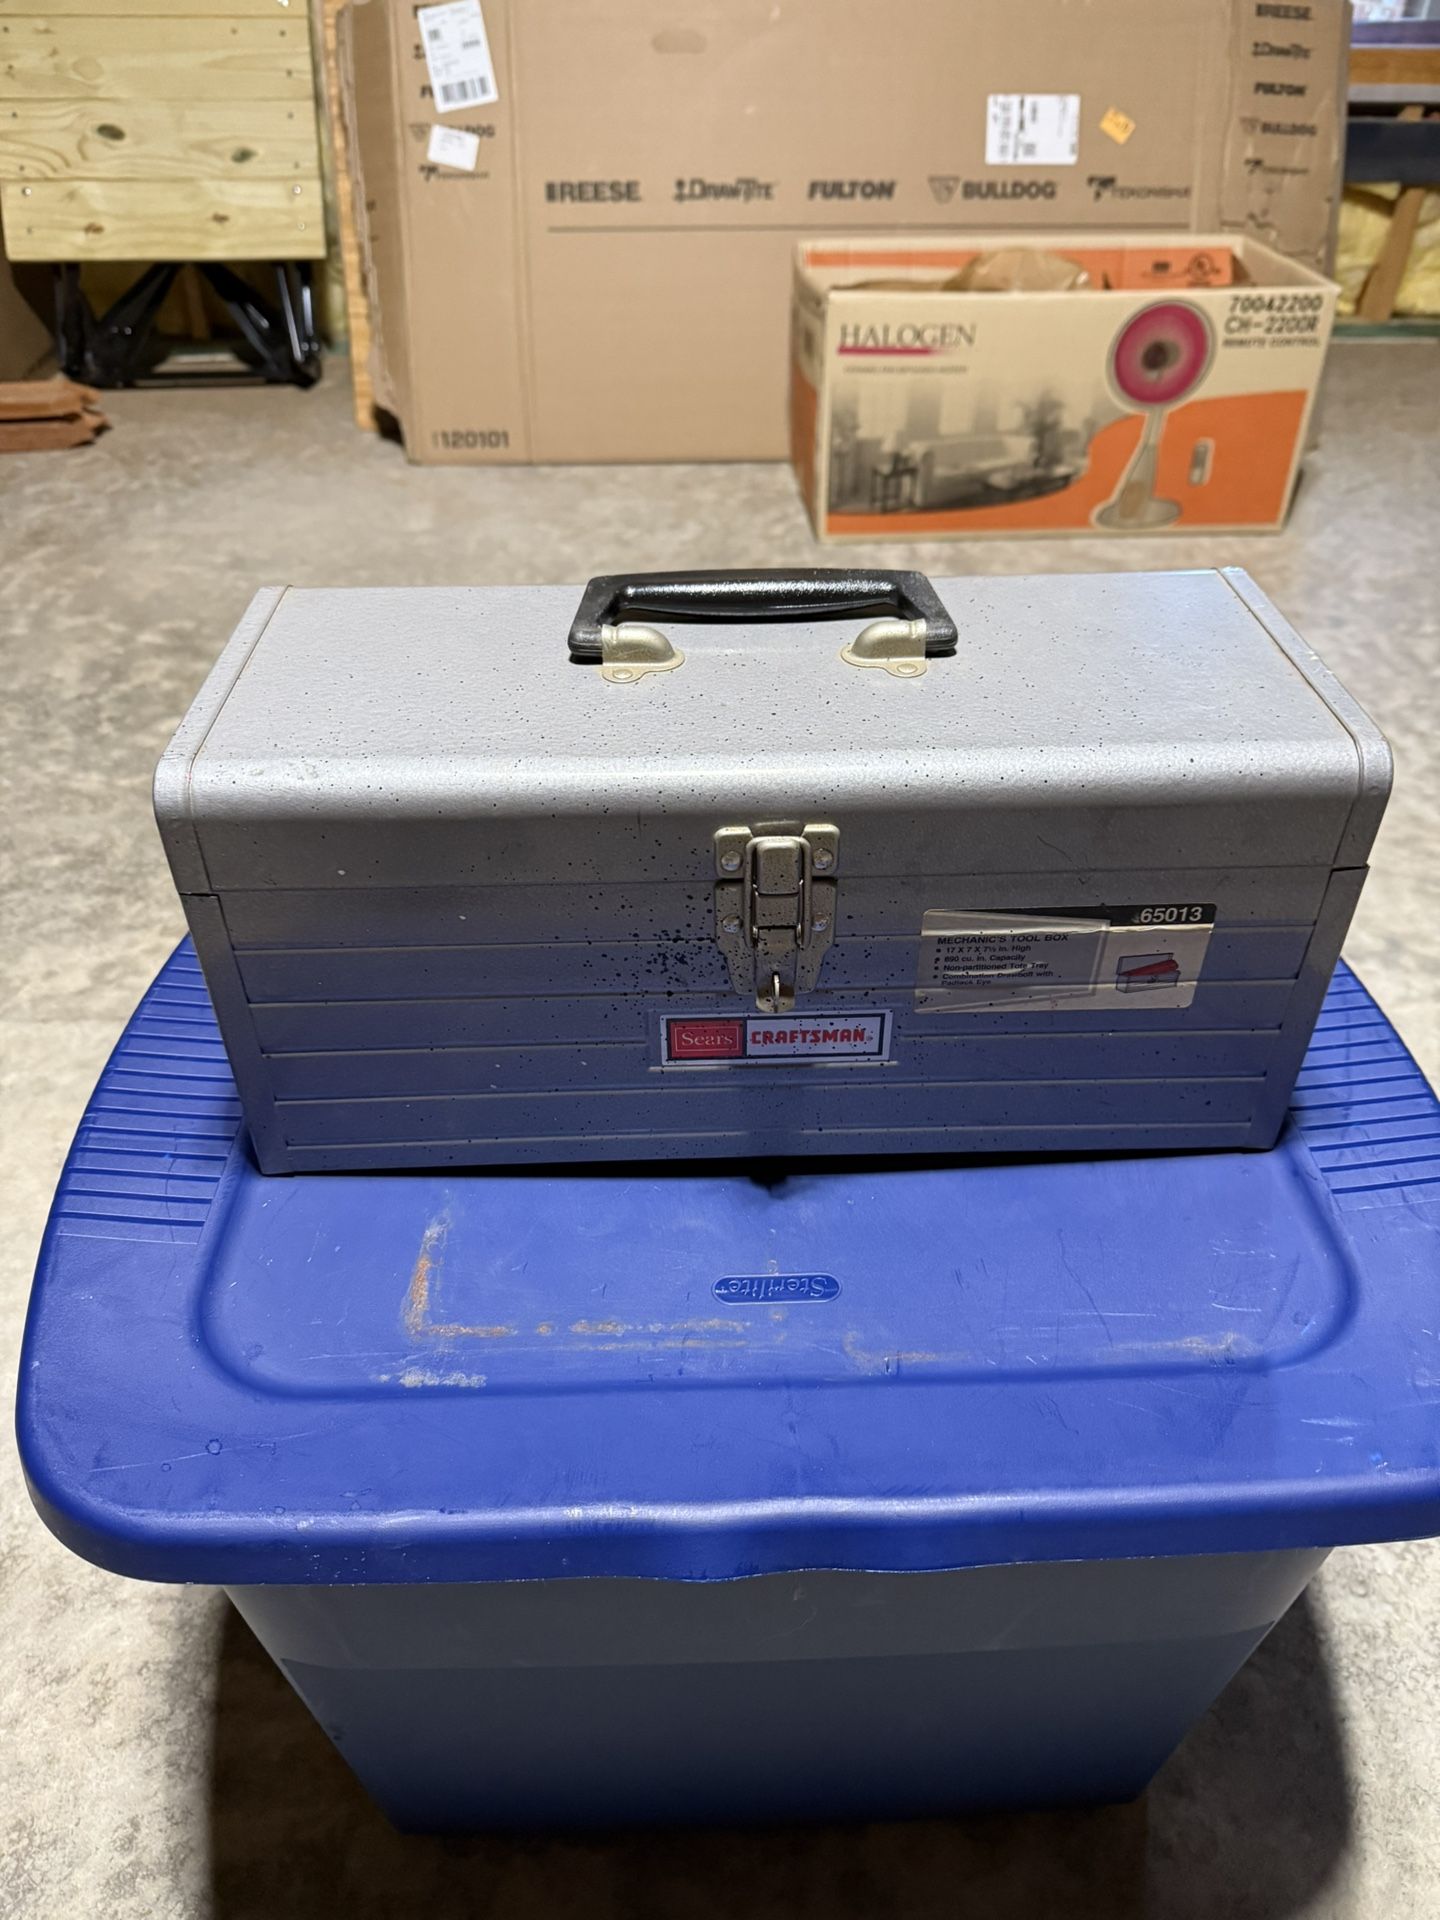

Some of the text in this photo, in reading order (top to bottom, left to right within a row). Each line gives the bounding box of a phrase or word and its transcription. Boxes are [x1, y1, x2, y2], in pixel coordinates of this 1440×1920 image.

[559, 180, 642, 203] REESE
[808, 180, 896, 200] FULTON
[961, 180, 1058, 200] BULLDOG
[1230, 294, 1323, 313] 70042200
[840, 323, 976, 347] HALOGEN
[1140, 906, 1203, 923] 65013
[937, 932, 1069, 945] MECHANIC'S TOOL BOX
[1012, 944, 1031, 952] High
[990, 954, 1026, 962] Capacity
[943, 963, 1007, 971] Non-partitioned
[680, 1031, 734, 1047] Sears
[751, 1028, 866, 1045] CRAFTSMAN
[728, 1276, 828, 1299] Sterilite
